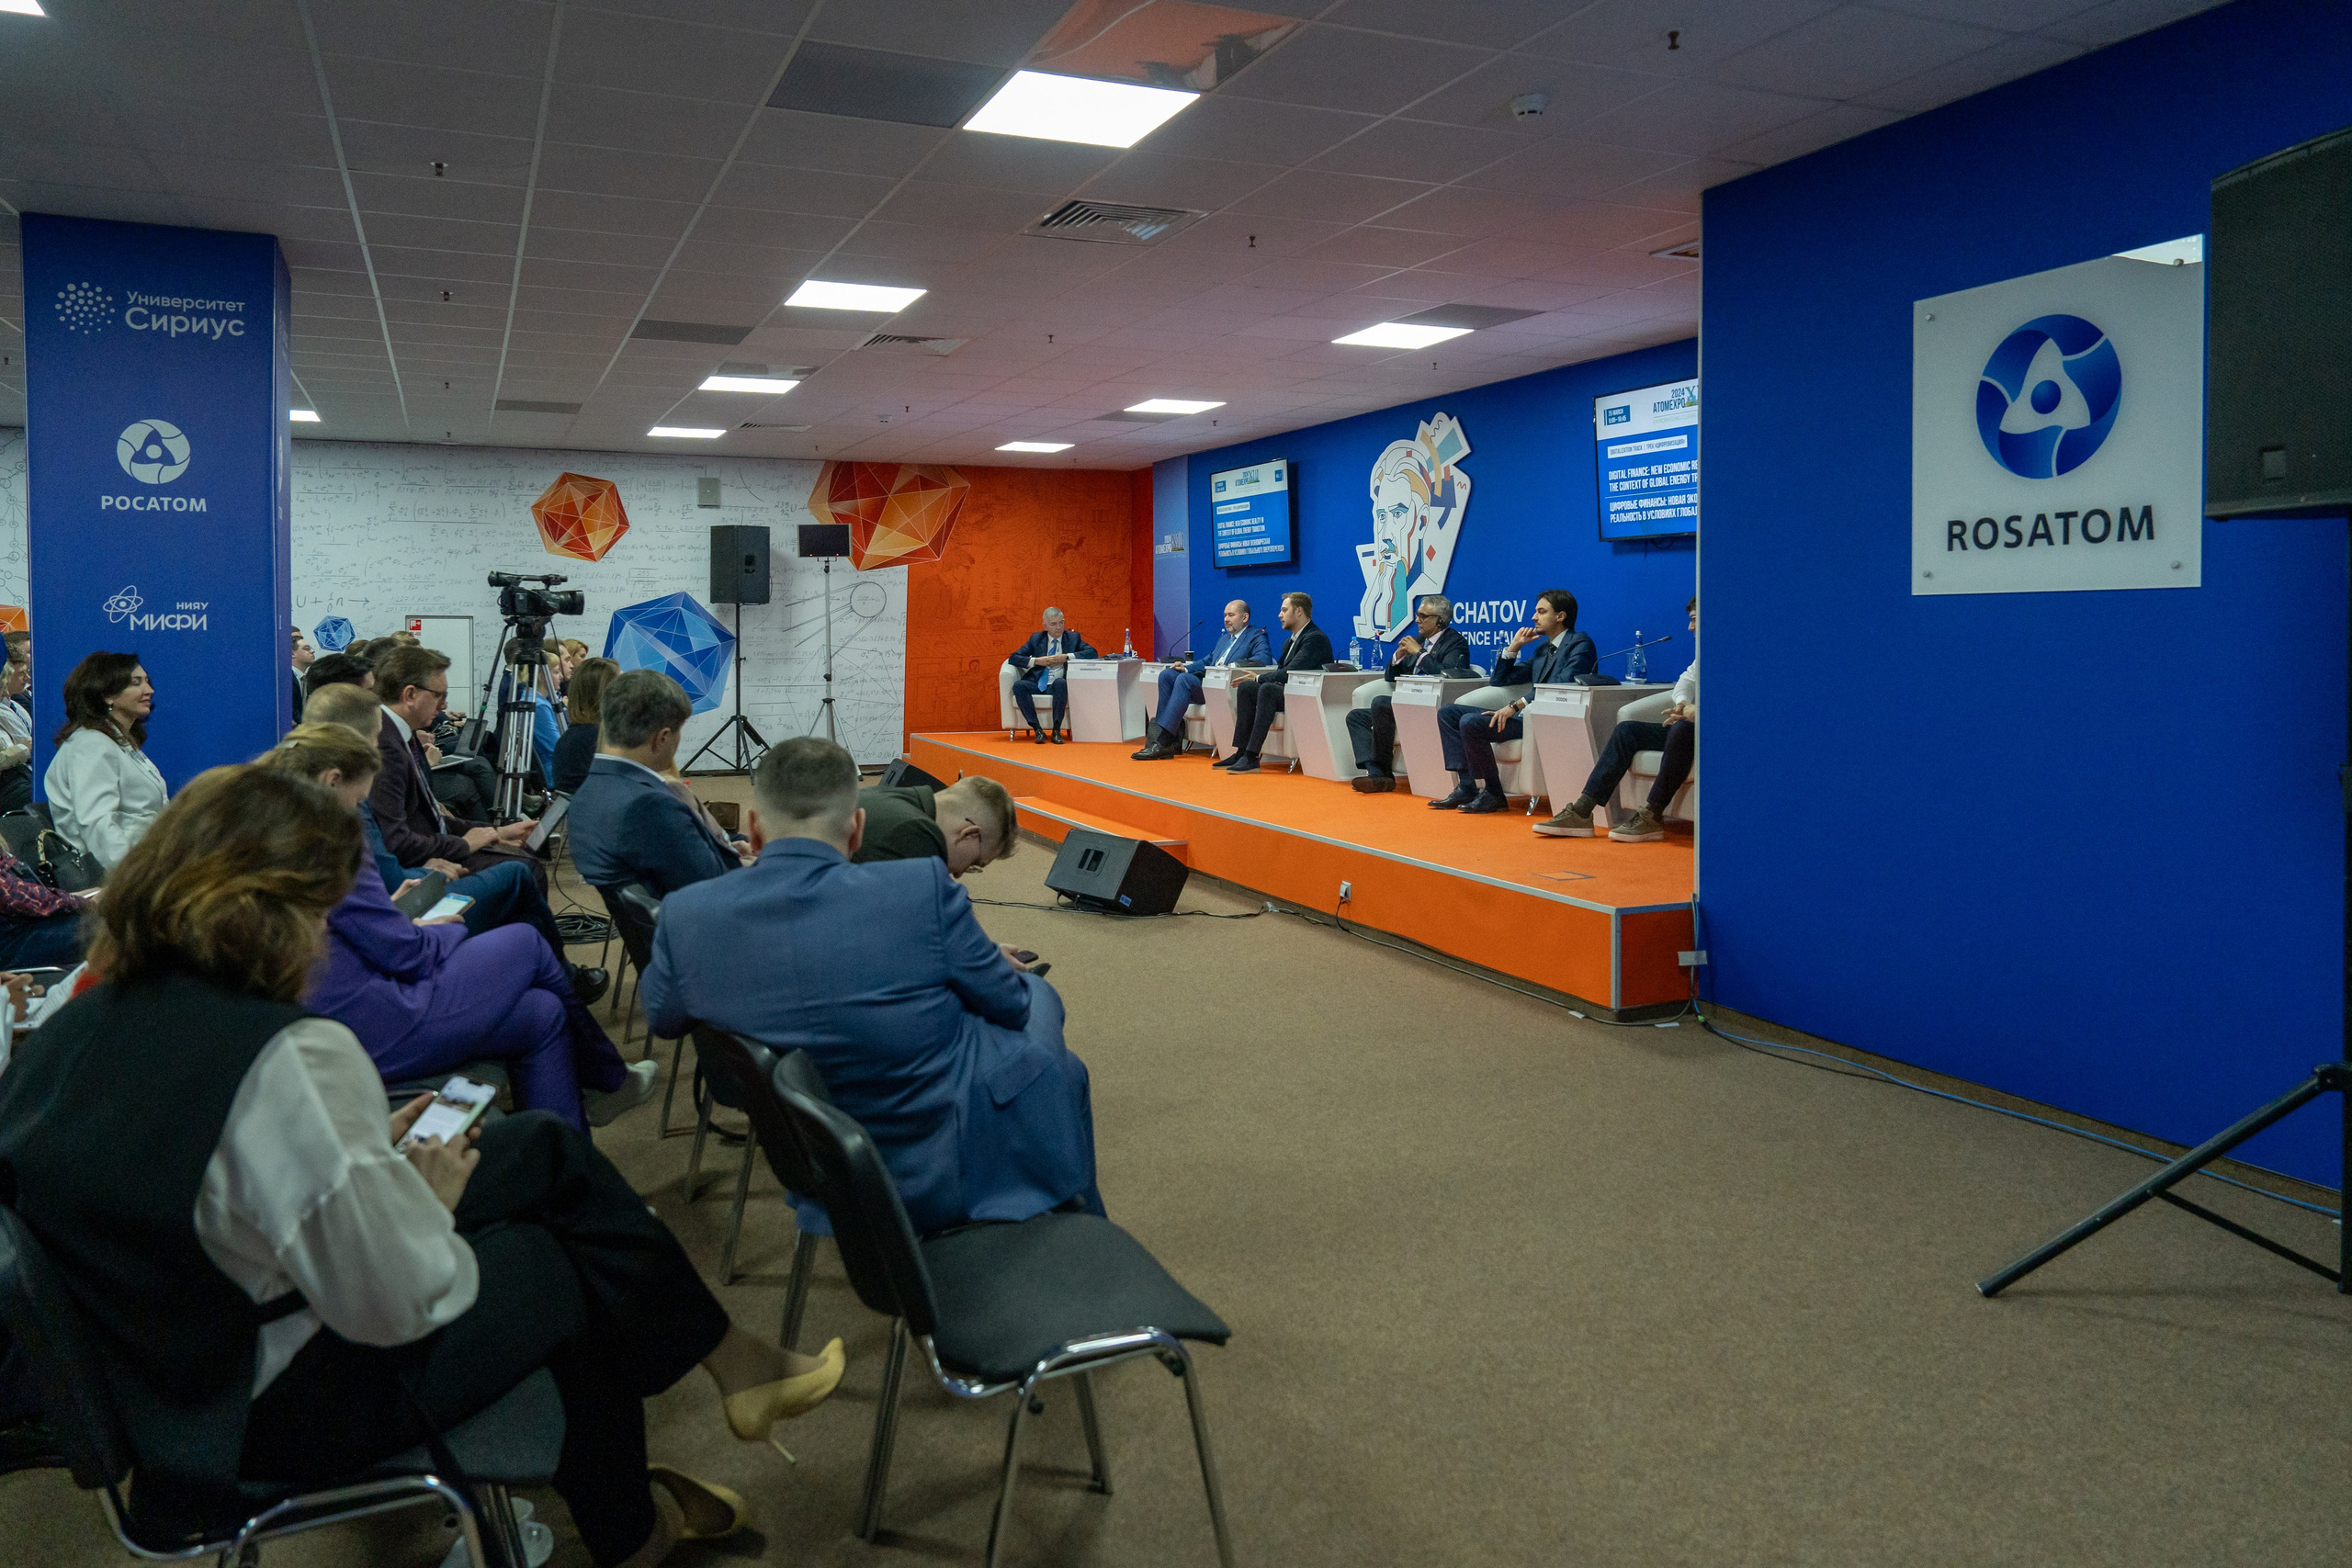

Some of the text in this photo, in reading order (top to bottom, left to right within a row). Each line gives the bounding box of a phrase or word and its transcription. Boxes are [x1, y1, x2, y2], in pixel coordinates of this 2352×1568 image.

[127, 291, 245, 312] Университет
[125, 307, 245, 340] Сириус
[1671, 388, 1685, 398] 2024
[1653, 398, 1686, 413] ATOMEXPO
[1608, 470, 1627, 481] DIGITAL
[1628, 466, 1650, 478] FINANCE:
[1651, 465, 1662, 475] NEW
[1664, 461, 1690, 474] ECONOMIC
[1609, 482, 1619, 492] THE
[1619, 479, 1641, 491] CONTEXT
[1642, 479, 1649, 488] OF
[1649, 477, 1669, 487] GLOBAL
[1670, 474, 1690, 485] ENERGY
[101, 496, 207, 512] РОСАТОМ
[1609, 500, 1638, 512] ЦИФРОВЫЕ
[1639, 496, 1667, 508] ФИНАНСЫ:
[1668, 495, 1686, 505] НОВАЯ
[1610, 511, 1642, 523] РЕАЛЬНОСТЬ
[1643, 511, 1646, 520] В
[1647, 508, 1676, 520] УСЛОВИЯХ
[1947, 505, 2154, 551] ROSATOM
[1450, 600, 1527, 624] CHATOV
[130, 614, 207, 631] МИФИ
[1458, 631, 1490, 645] ENCE
